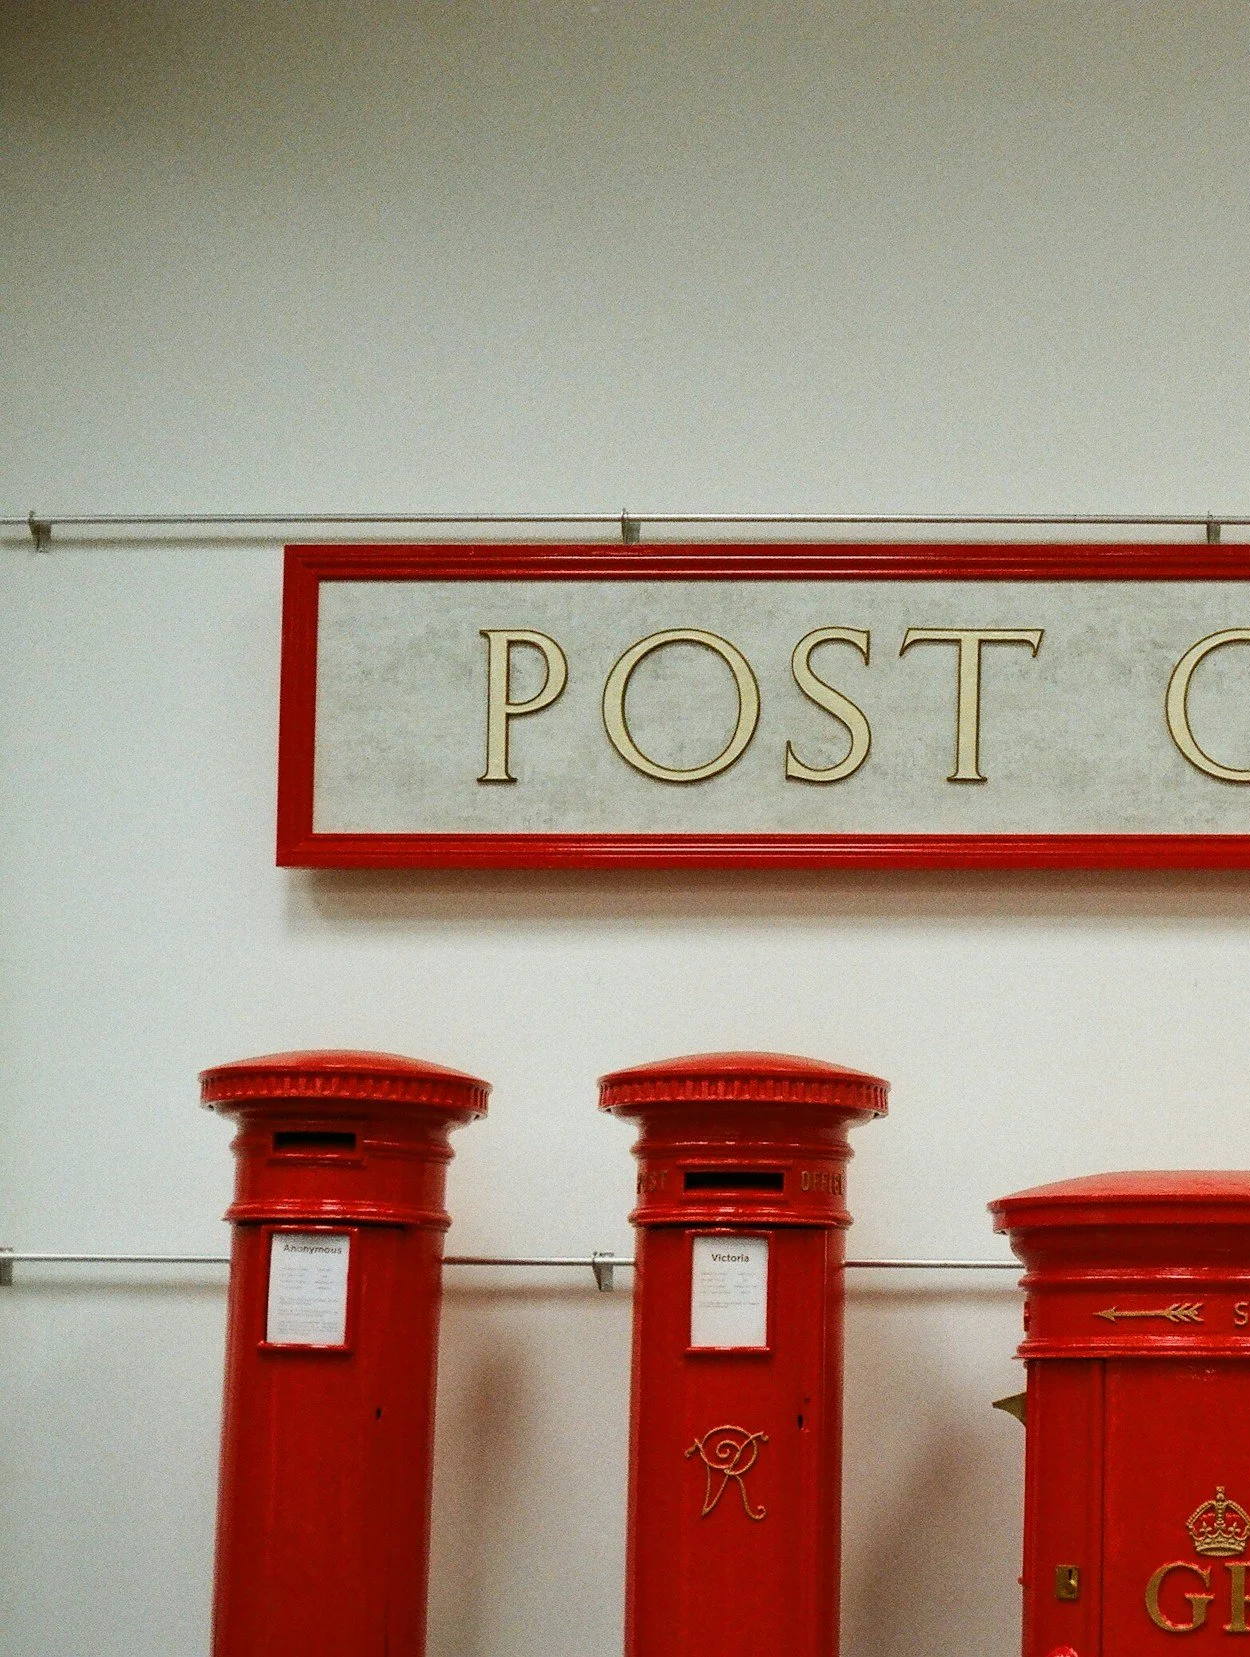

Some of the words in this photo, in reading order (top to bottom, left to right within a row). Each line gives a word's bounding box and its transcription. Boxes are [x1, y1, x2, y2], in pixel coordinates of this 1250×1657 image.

[477, 626, 1046, 784] POST
[283, 1244, 342, 1254] Anonymous
[711, 1253, 750, 1263] Victoria
